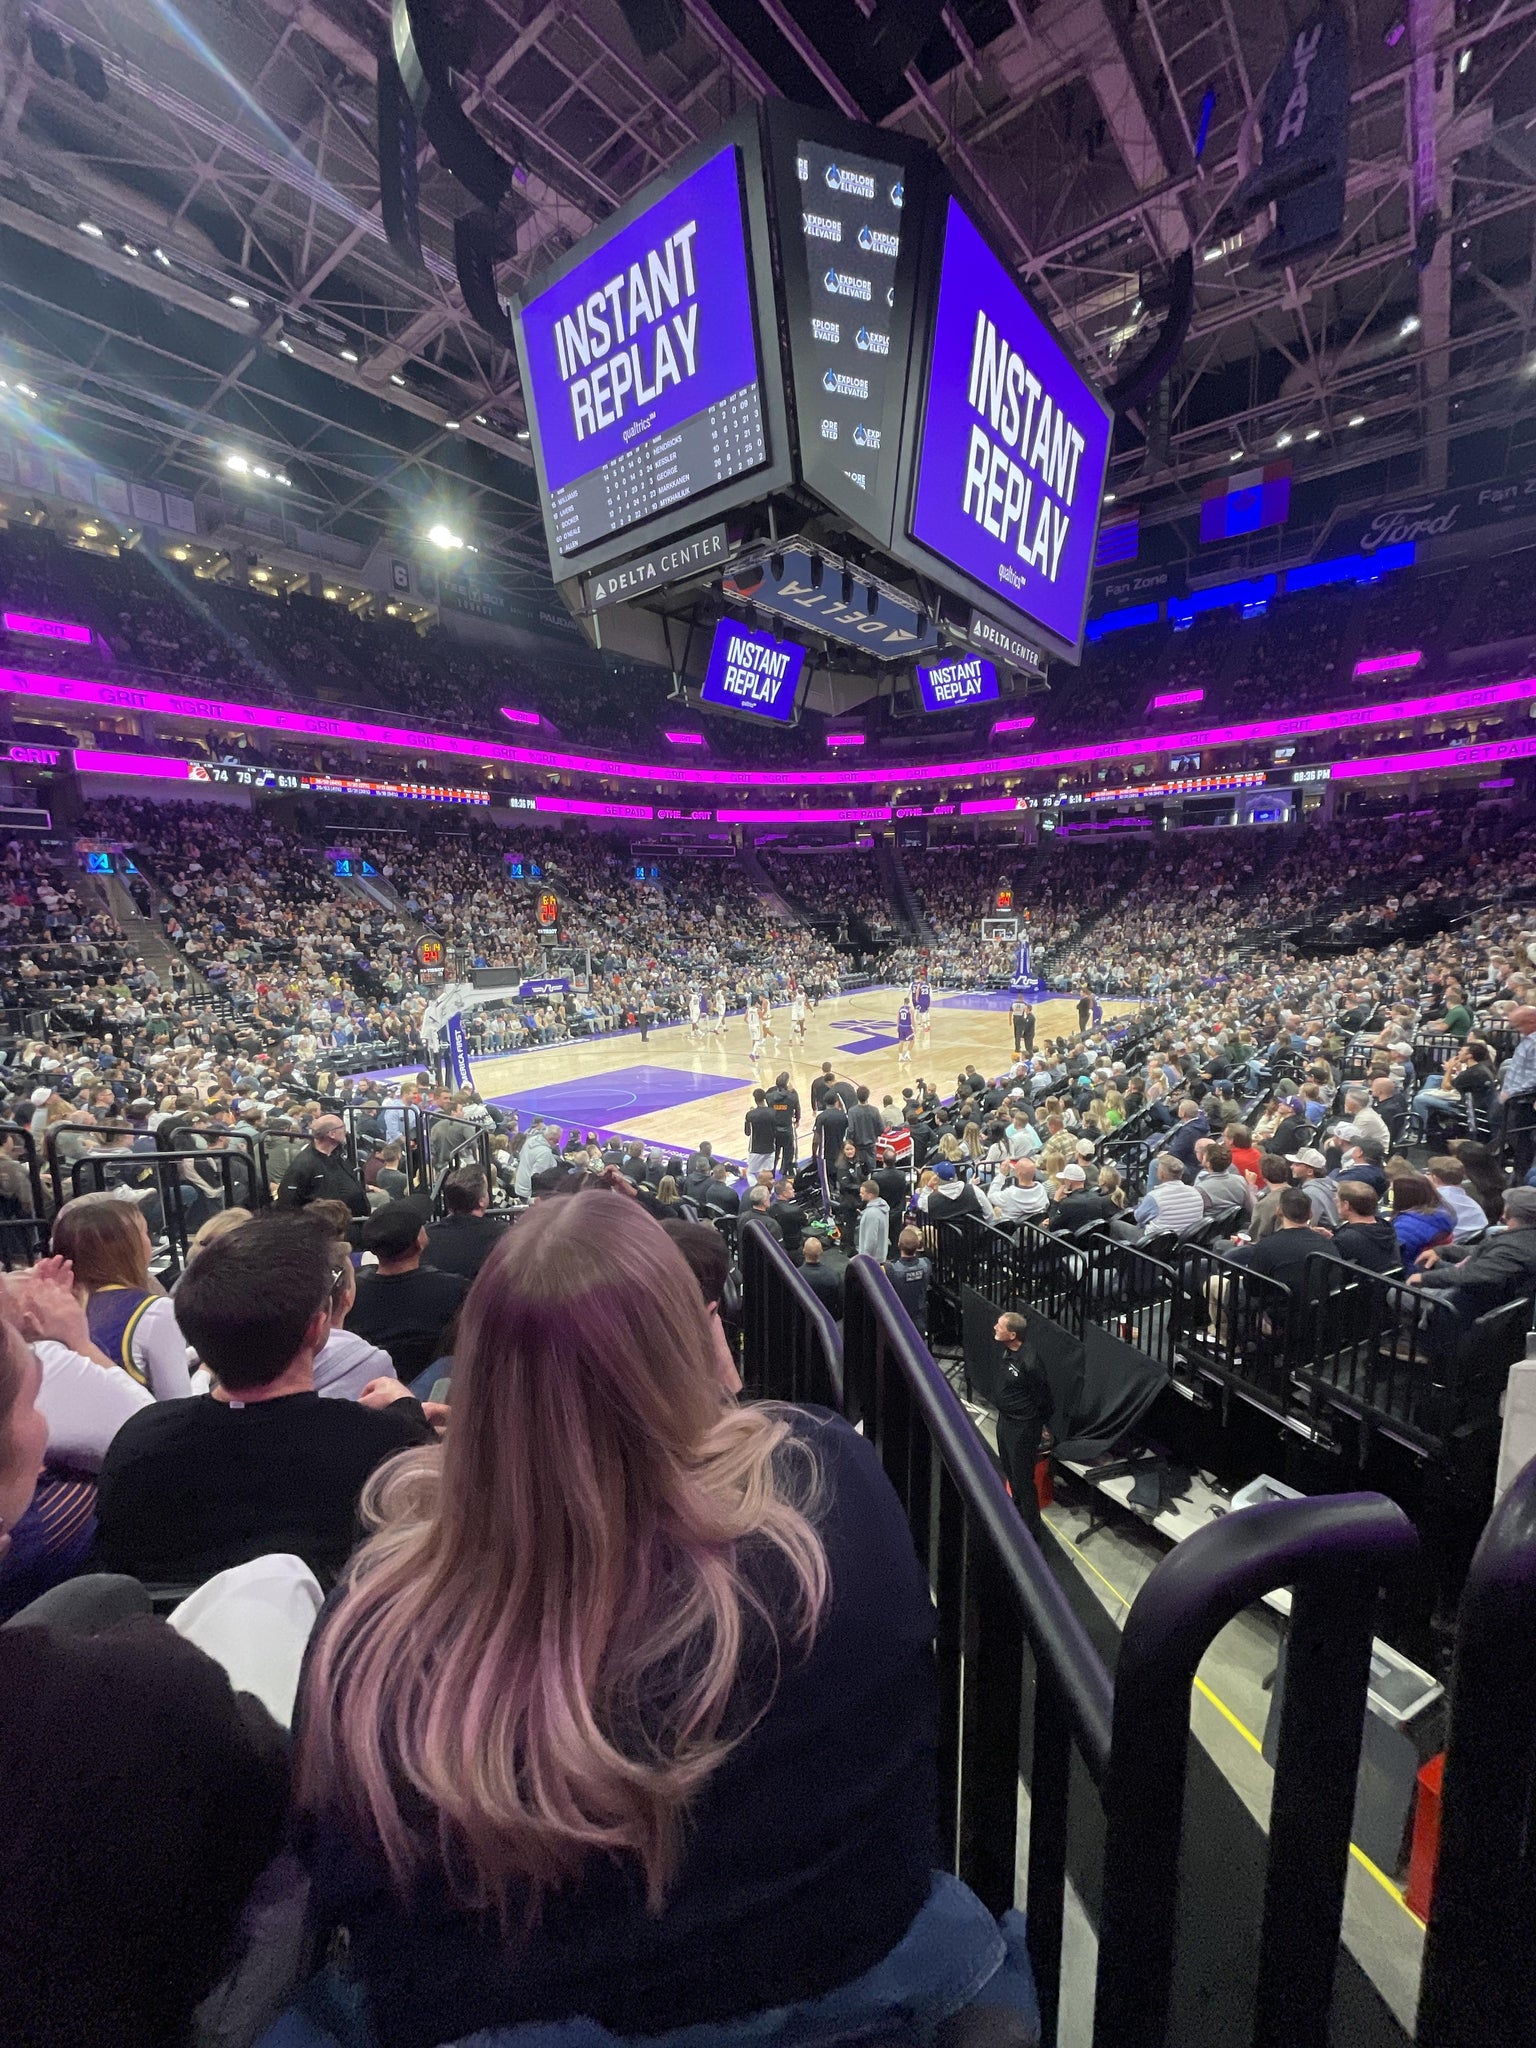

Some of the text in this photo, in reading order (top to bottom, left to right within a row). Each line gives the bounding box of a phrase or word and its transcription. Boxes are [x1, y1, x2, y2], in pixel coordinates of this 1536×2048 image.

[1276, 23, 1322, 147] UTAH
[841, 170, 874, 186] EXPLORE
[841, 182, 874, 198] ELEVATED
[808, 214, 842, 231] EXPLORE
[808, 227, 842, 242] ELEVATED
[840, 274, 872, 290] EXPLORE
[554, 220, 696, 381] INSTANT
[839, 286, 872, 301] ELEVATED
[570, 302, 698, 442] REPLAY
[838, 374, 868, 388] EXPLORE
[838, 386, 868, 399] ELEVATED
[969, 310, 1084, 506] INSTANT
[652, 434, 683, 456] HENDRICKS
[654, 450, 678, 470] KESSLER
[656, 464, 679, 482] GEORGE
[658, 473, 691, 495] MARKKANEN
[962, 424, 1070, 582] REPLAY
[1478, 486, 1518, 505] Fan
[1360, 503, 1460, 550] Ford
[564, 540, 579, 552] ALLEN
[608, 536, 722, 593] DELTA CENTER
[394, 567, 408, 586] 6
[1106, 574, 1168, 597] Fan Zone
[778, 580, 888, 632] DELTA
[984, 624, 1039, 666] DELTA CENTER
[726, 636, 790, 678] INSTANT
[929, 660, 982, 686] INSTANT
[724, 666, 782, 704] REPLAY
[934, 678, 982, 702] REPLAY
[98, 687, 148, 707] GRIT
[1456, 688, 1500, 706] GRIT
[181, 700, 225, 718] GRIT
[305, 719, 341, 734] GRIT
[1276, 719, 1312, 734] GRIT
[406, 734, 438, 748] GRIT
[1180, 733, 1210, 746] GRIT
[1456, 748, 1492, 763] GET
[213, 770, 228, 782] 74
[236, 772, 252, 784] 79
[278, 775, 298, 788] 6:14
[1294, 769, 1330, 782] 08:36 PM
[605, 806, 646, 818] GET PAID
[1030, 800, 1038, 808] 74
[1043, 798, 1052, 806] 79
[838, 810, 884, 820] GET PAID
[424, 944, 440, 952] 6:14
[424, 952, 438, 962] 24
[454, 1030, 463, 1052] FIRST
